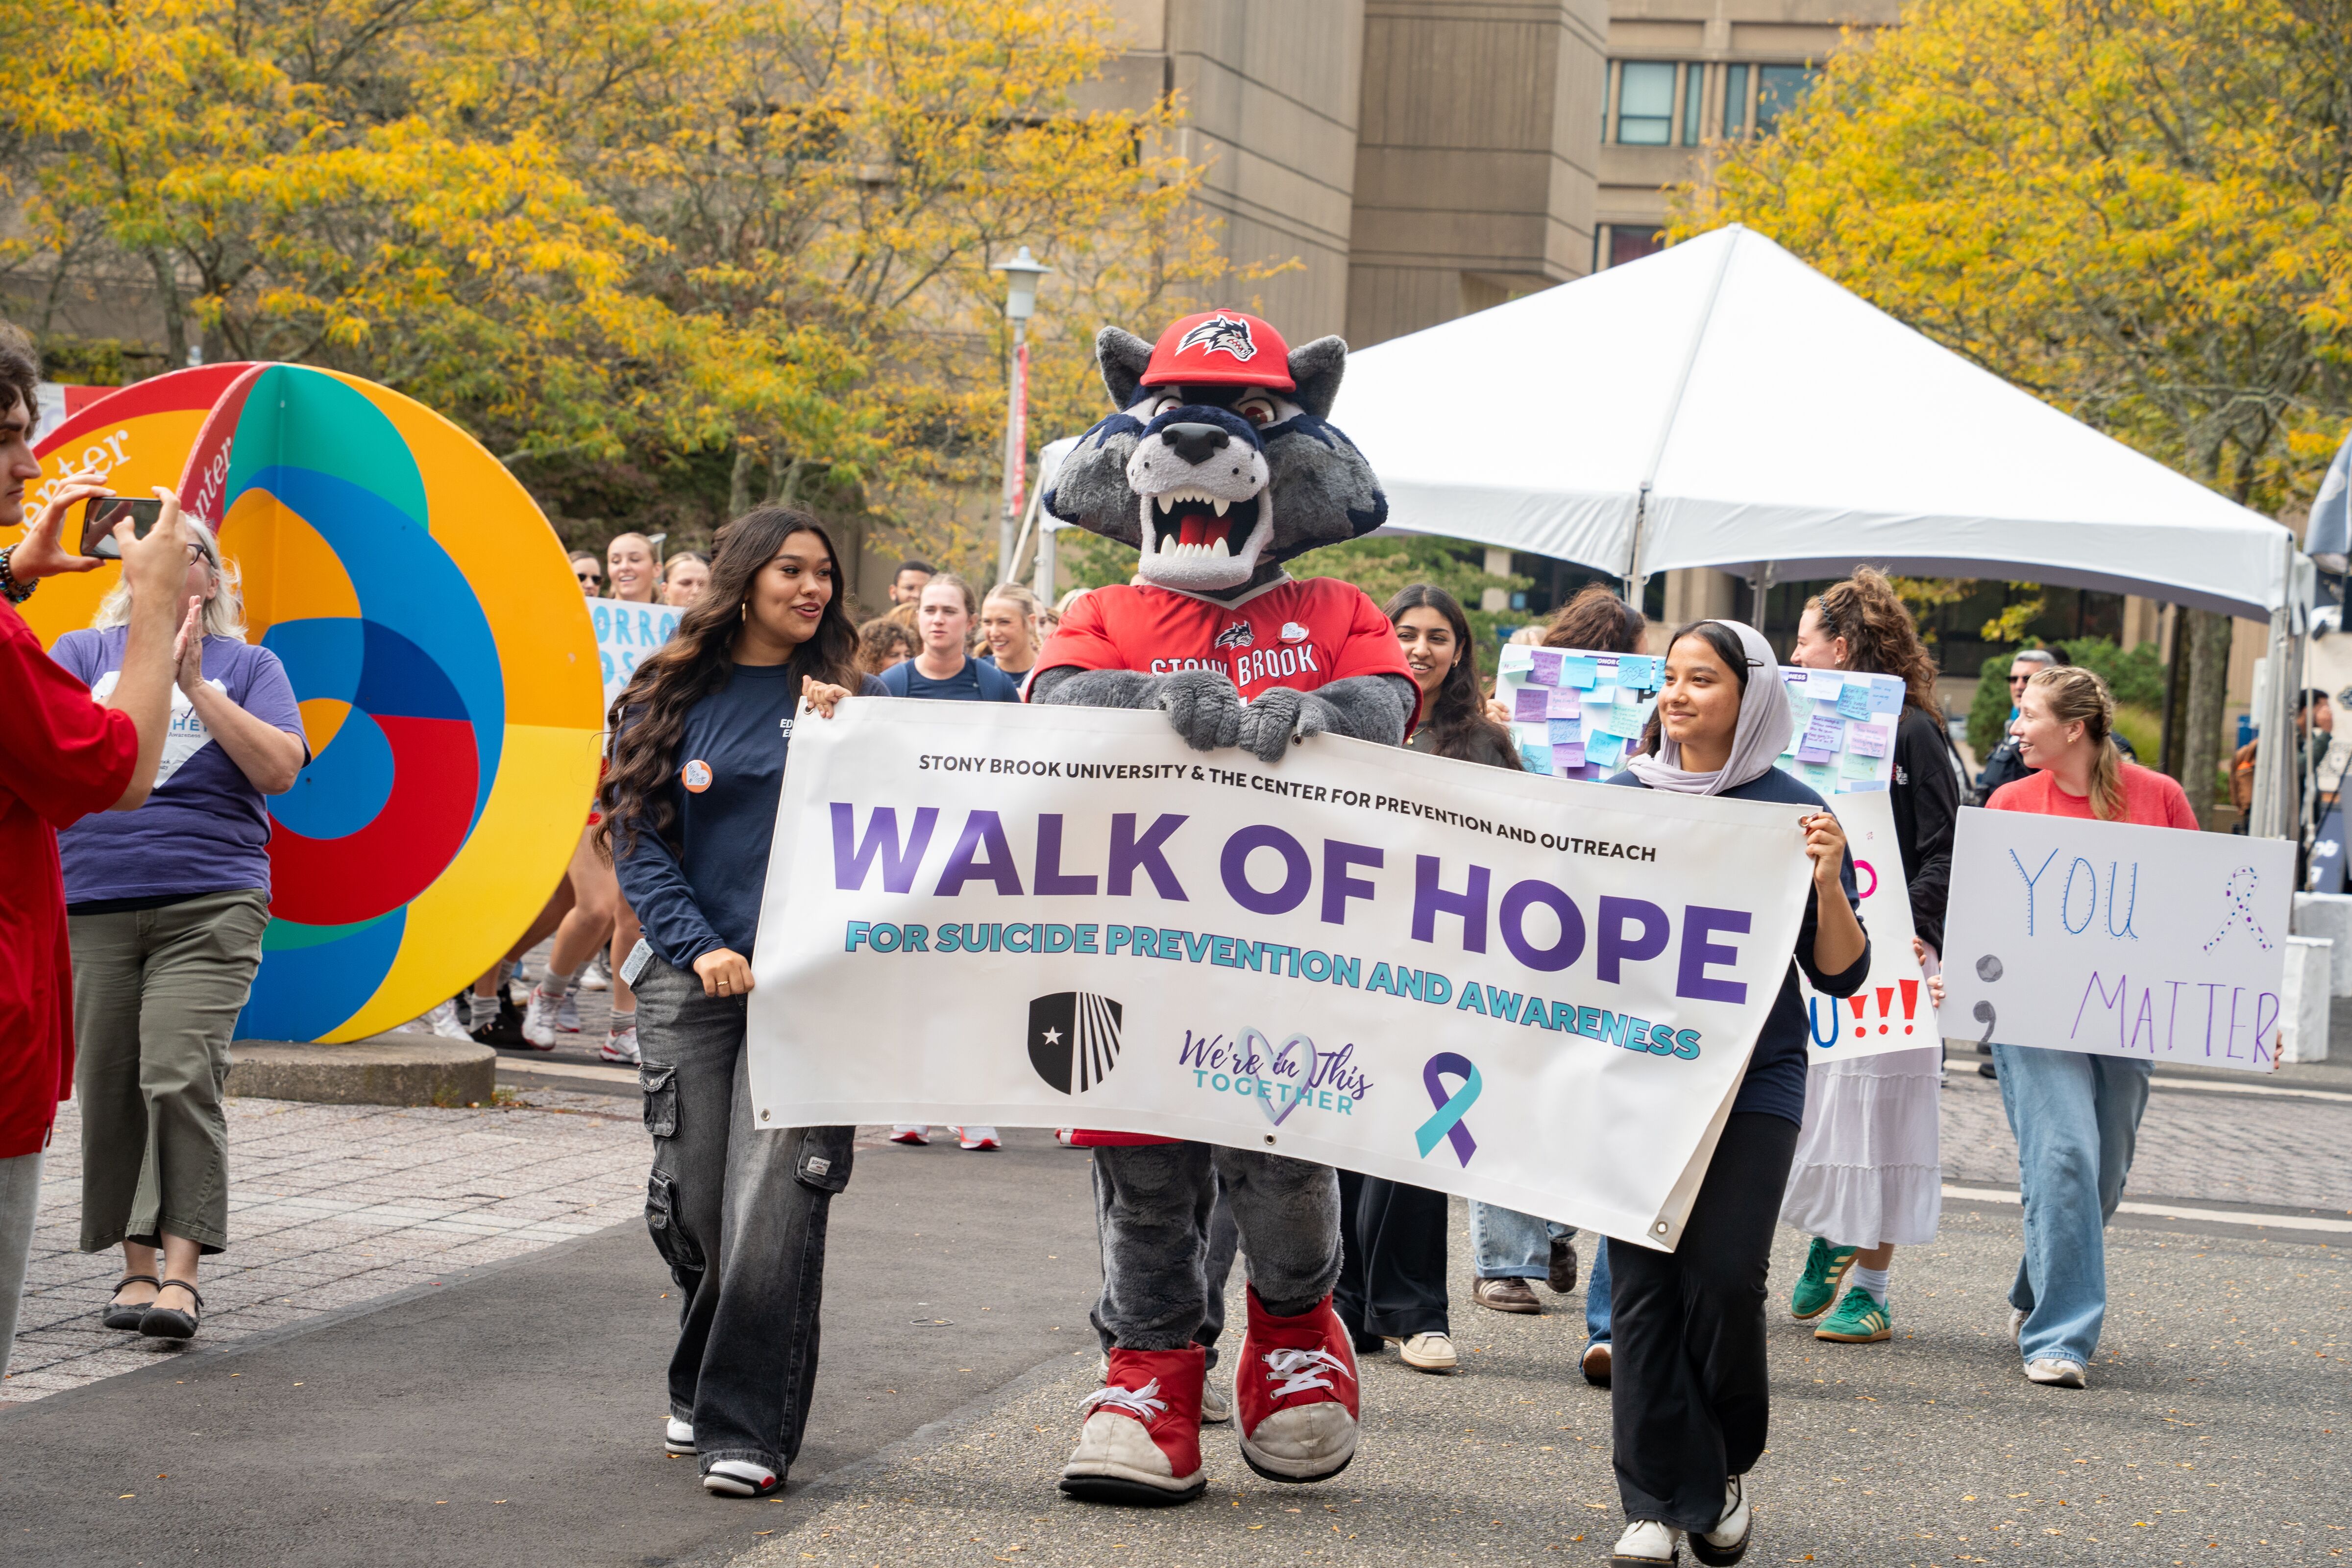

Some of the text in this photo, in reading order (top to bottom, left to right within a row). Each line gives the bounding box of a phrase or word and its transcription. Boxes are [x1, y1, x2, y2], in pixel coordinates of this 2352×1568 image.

[21, 429, 131, 535] enter
[1238, 644, 1318, 687] BROOK
[918, 755, 1657, 862] STONY BROOK UNIVERSITY & THE CENTER FOR PREVENTION AND OUTREACH
[829, 802, 1752, 1005] WALK OF HOPE
[2008, 847, 2139, 942] YOU
[845, 920, 1703, 1061] FOR SUICIDE PREVENTION AND AWARENESS
[2070, 970, 2279, 1063] MATTER
[1178, 1029, 1374, 1101] We're in This
[1192, 1069, 1354, 1116] TOGETHER
